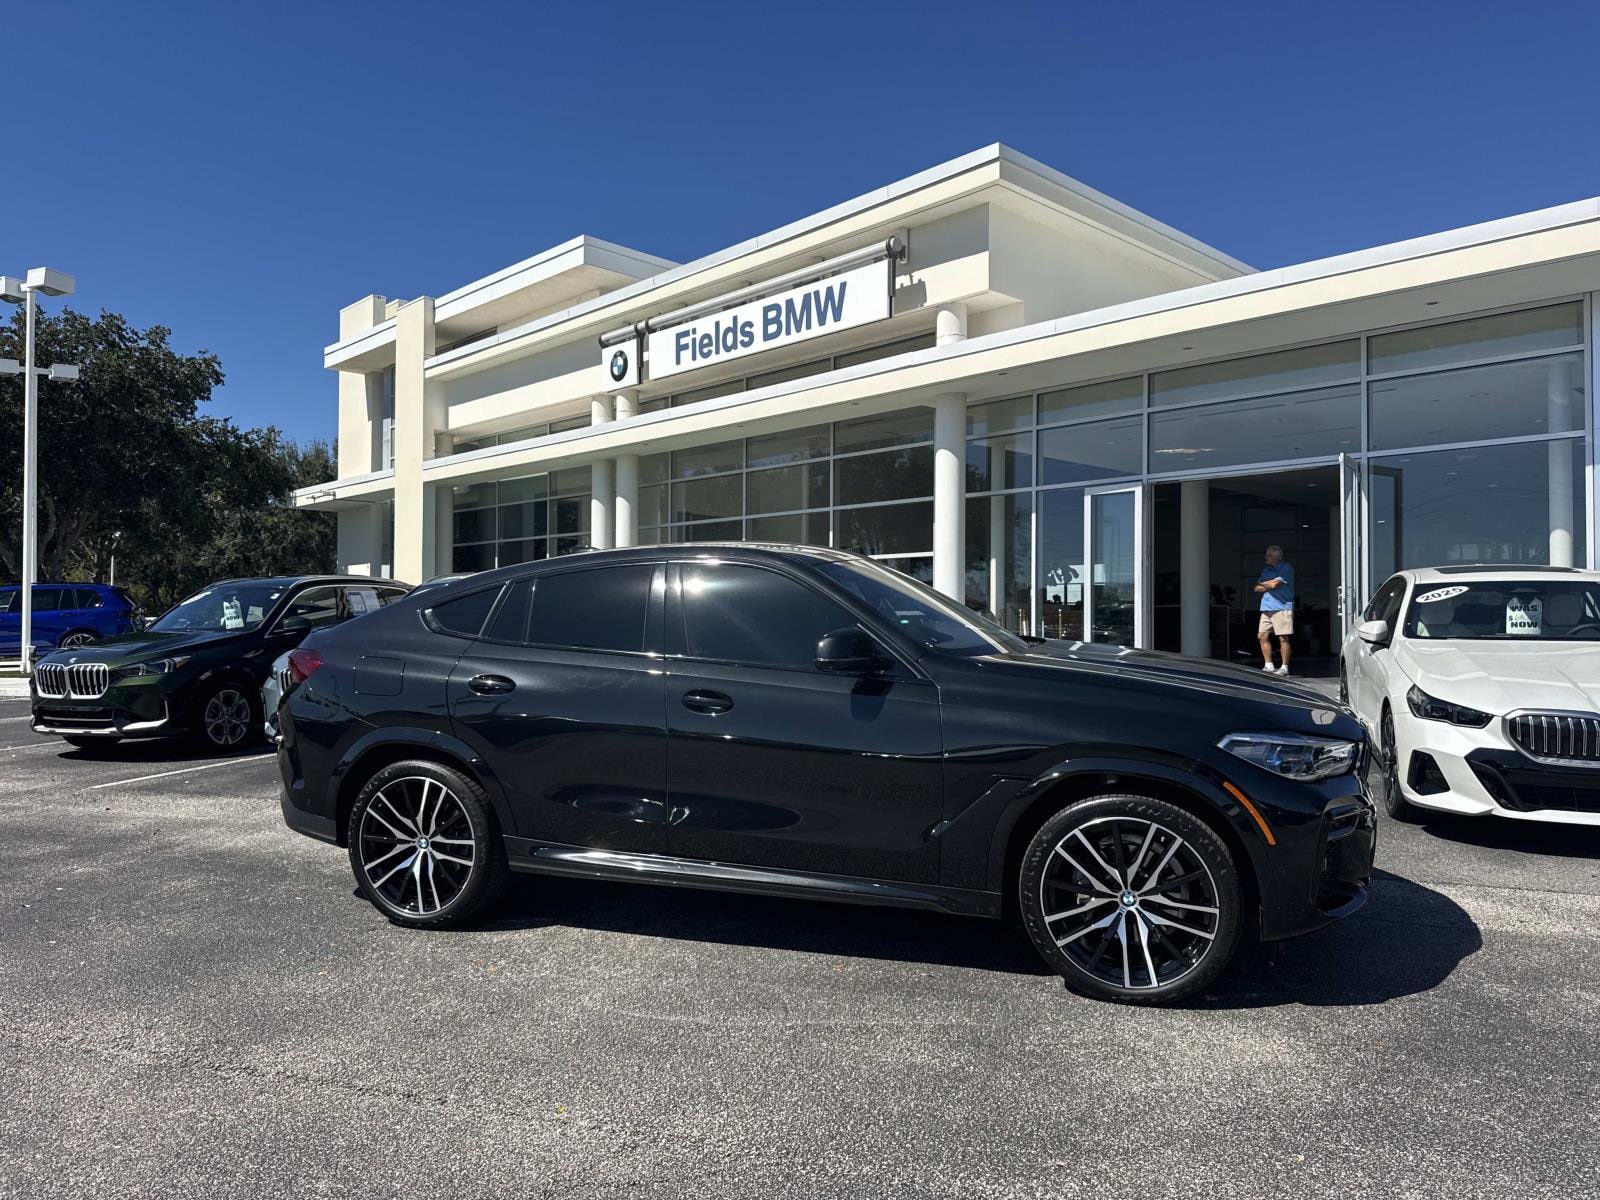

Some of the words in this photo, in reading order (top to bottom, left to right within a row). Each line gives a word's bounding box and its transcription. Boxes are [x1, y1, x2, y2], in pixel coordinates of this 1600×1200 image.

[675, 315, 755, 365] Fields
[762, 281, 848, 342] BMW
[1420, 588, 1463, 602] 2025
[1510, 604, 1538, 612] WAS
